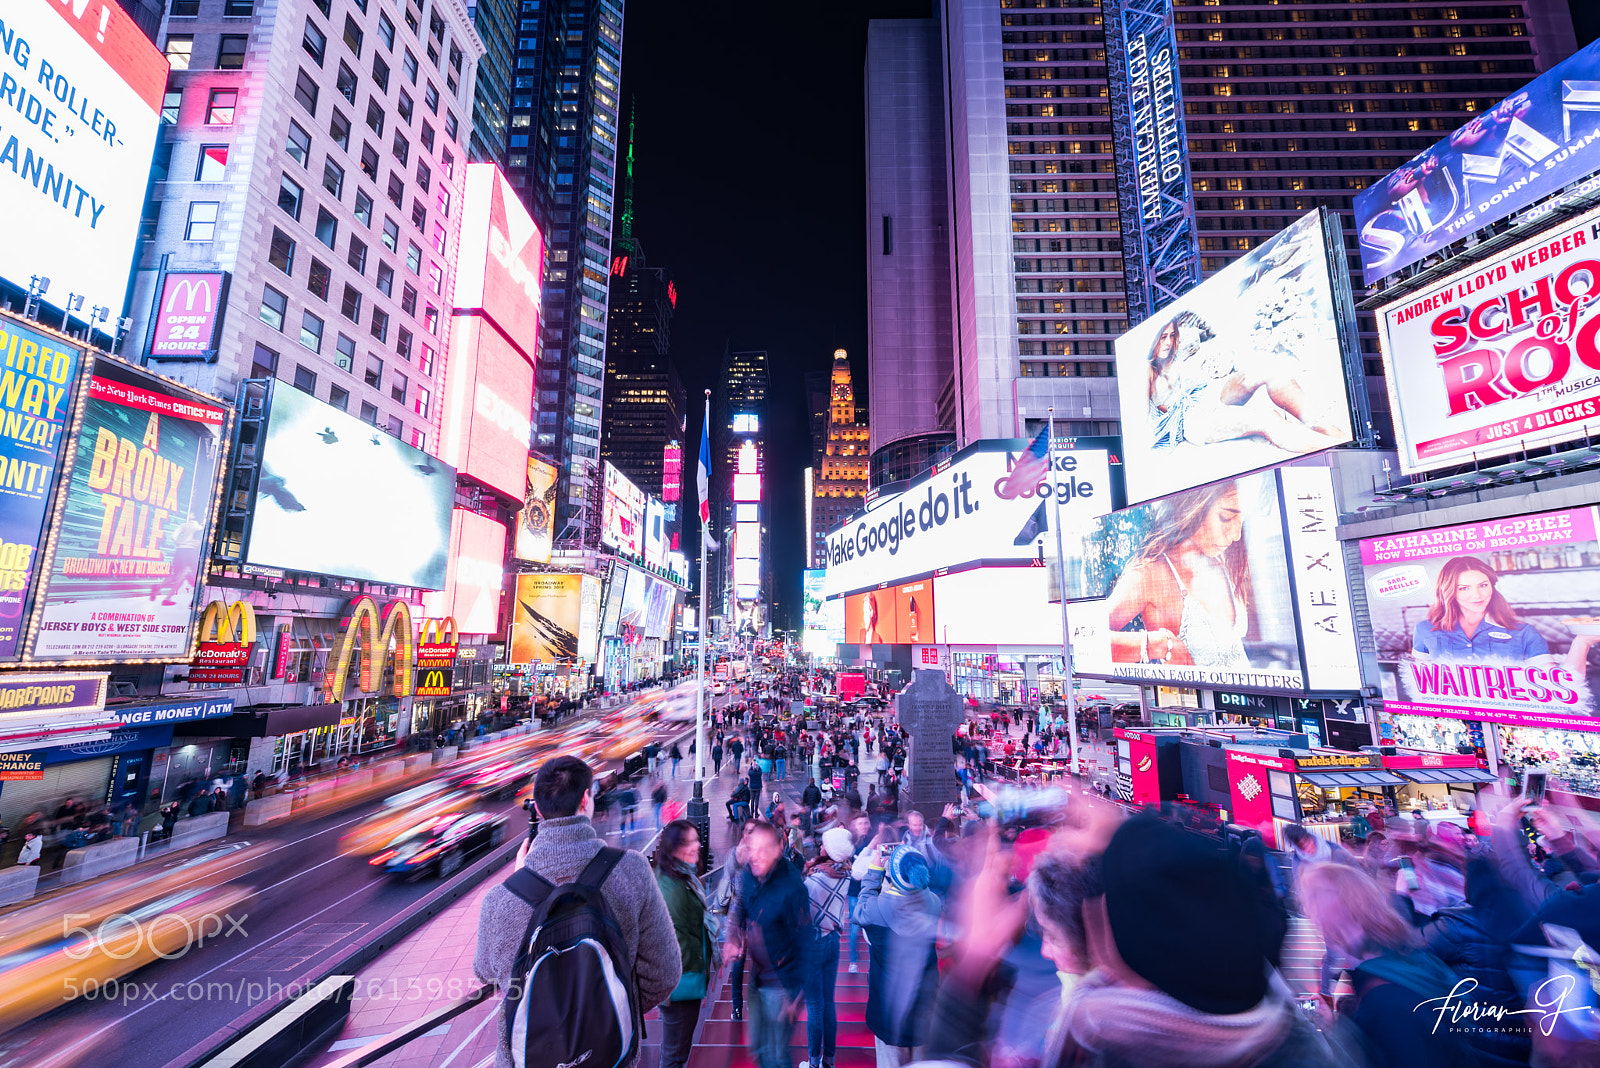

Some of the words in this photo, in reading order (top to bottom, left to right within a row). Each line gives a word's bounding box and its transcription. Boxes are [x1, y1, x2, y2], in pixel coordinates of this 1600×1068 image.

[1128, 34, 1150, 105] EAGLE
[38, 58, 124, 147] ROLLER-
[1151, 48, 1181, 183] OUTFITTERS
[1134, 104, 1161, 219] AMERICAN
[0, 126, 105, 230] ANNITY
[1444, 210, 1475, 234] THE
[1479, 171, 1541, 212] DONNA
[1458, 265, 1507, 299] LLOYD
[1511, 230, 1586, 274] WEBBER
[167, 316, 206, 324] OPEN
[1536, 296, 1589, 342] of
[168, 327, 199, 340] 24
[157, 341, 206, 350] HOURS
[90, 380, 106, 392] The
[107, 384, 126, 398] New
[127, 390, 147, 404] York
[147, 395, 171, 410] Times
[206, 410, 224, 420] PICK
[1541, 385, 1557, 396] THE
[1486, 419, 1520, 439] JUST
[1523, 416, 1533, 430] 4
[1537, 400, 1596, 427] BLOCKS
[142, 411, 161, 452] A
[88, 426, 185, 514] BRONX
[1007, 452, 1078, 473] Mke
[97, 493, 169, 559] TALE
[826, 534, 854, 567] Make
[856, 502, 916, 555] Google
[919, 486, 949, 532] do
[954, 471, 979, 519] it.
[1373, 527, 1477, 552] KATHARINE
[1375, 550, 1401, 561] NOW
[1404, 543, 1462, 558] STARRING
[1465, 540, 1486, 550] ON
[1490, 529, 1573, 547] BROADWAY
[0, 541, 32, 571] OB
[119, 559, 136, 575] NEW
[1379, 579, 1419, 593] BAREILLES
[1387, 576, 1406, 585] SARA
[40, 621, 79, 631] JERSEY
[81, 622, 107, 632] BOYS
[108, 623, 115, 632] &
[117, 624, 141, 632] WEST
[142, 624, 160, 633] SIDE
[98, 612, 146, 622] COMBINATION
[147, 614, 155, 622] OF
[520, 663, 556, 671] LUGAGE
[1113, 667, 1166, 679] AMERICAN
[1169, 669, 1206, 682] EAGLE
[1210, 672, 1302, 689] OUTFITTERS
[1410, 662, 1578, 704] WAITRESS
[155, 706, 201, 721] MONEY
[208, 703, 232, 715] ATM
[1221, 693, 1267, 708] DRINK
[1412, 705, 1441, 713] ATKINSON
[1442, 707, 1470, 715] THEATRE
[0, 754, 31, 762] ONEY
[1231, 753, 1256, 764] belgian
[1258, 759, 1283, 768] waffles
[1297, 755, 1370, 768] wafels&dinges
